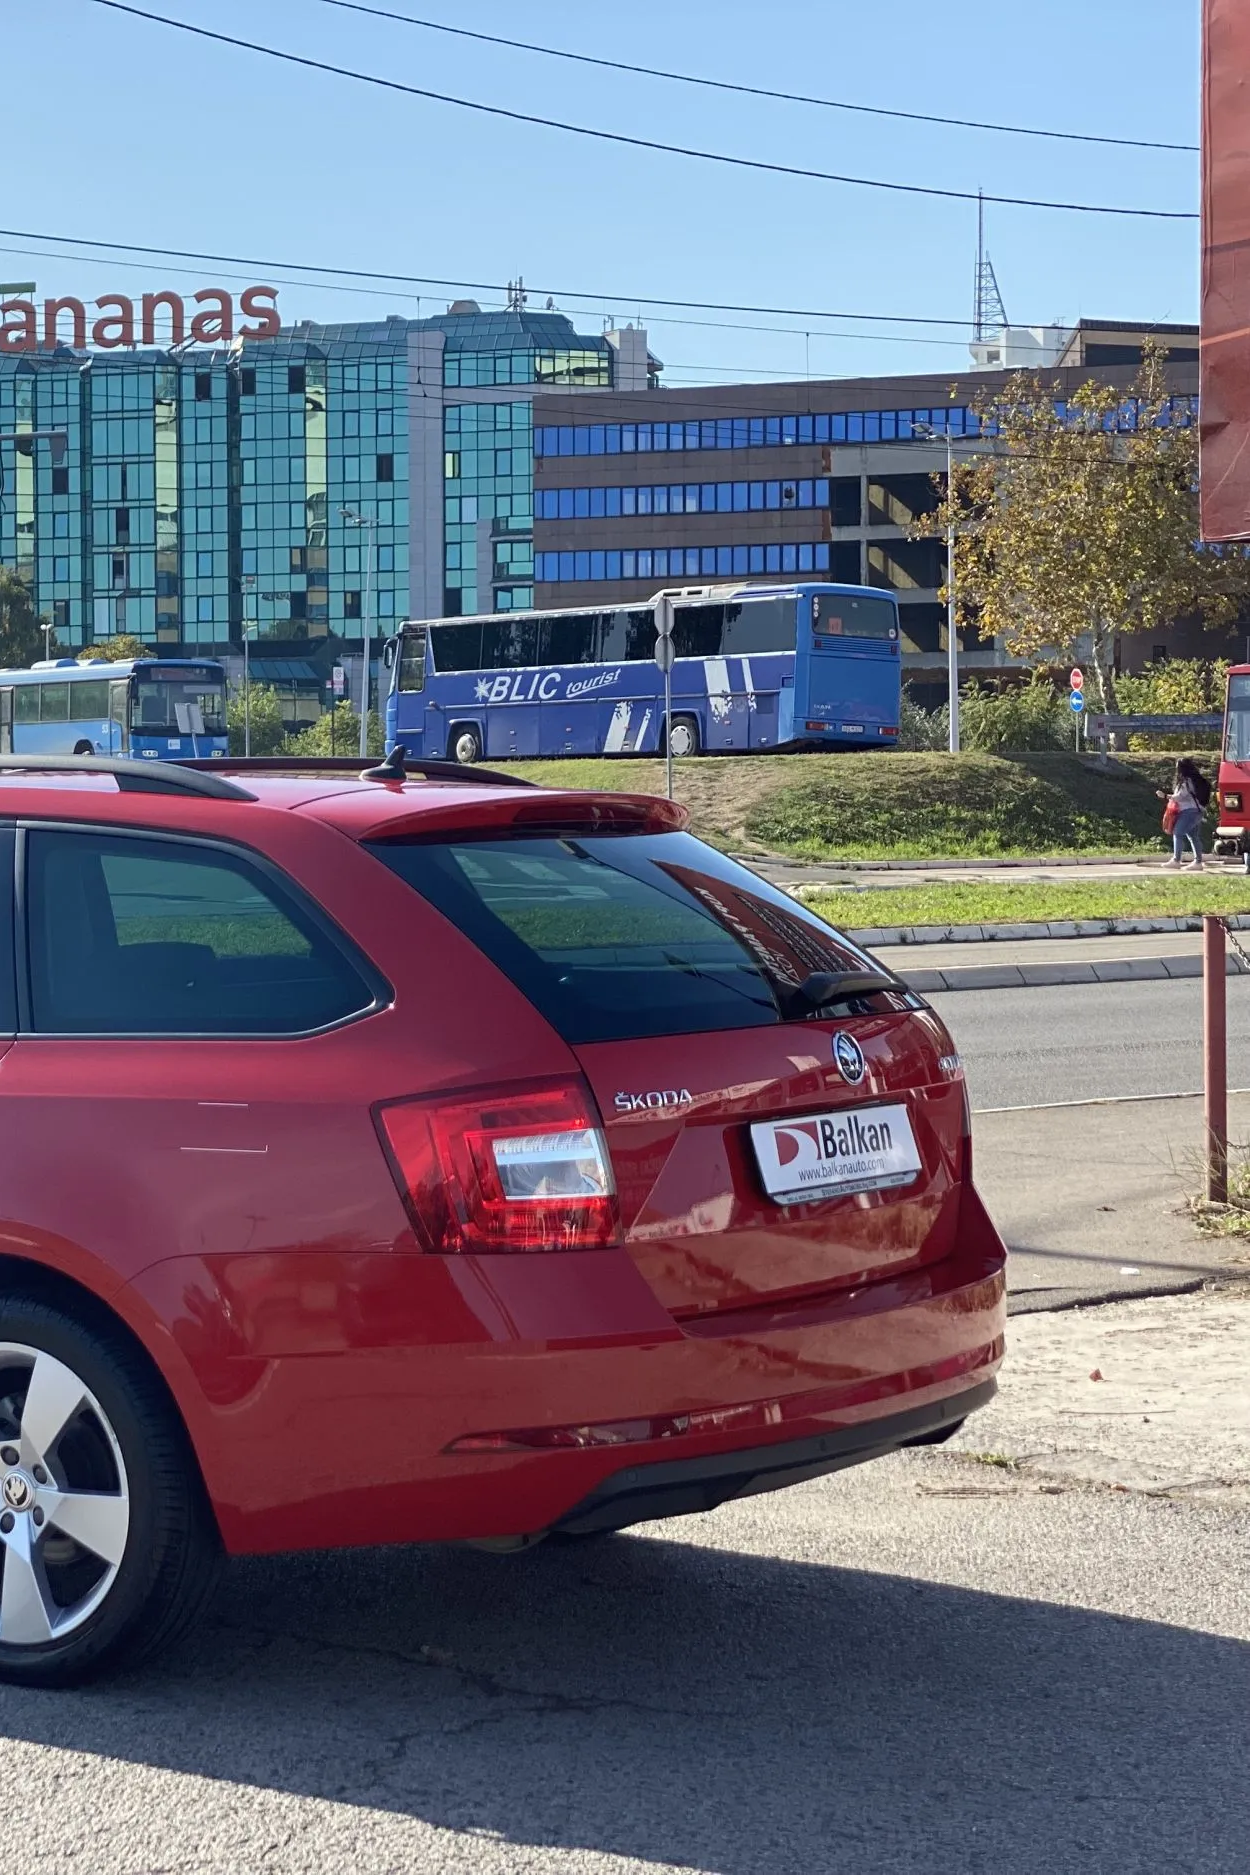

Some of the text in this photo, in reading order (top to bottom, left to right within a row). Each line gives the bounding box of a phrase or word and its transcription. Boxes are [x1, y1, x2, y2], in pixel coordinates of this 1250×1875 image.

[488, 668, 621, 702] BLIC tourist
[614, 1088, 693, 1112] ŠKODA
[820, 1115, 893, 1159] Balkan
[799, 1157, 885, 1181] www.balkanauto.com
